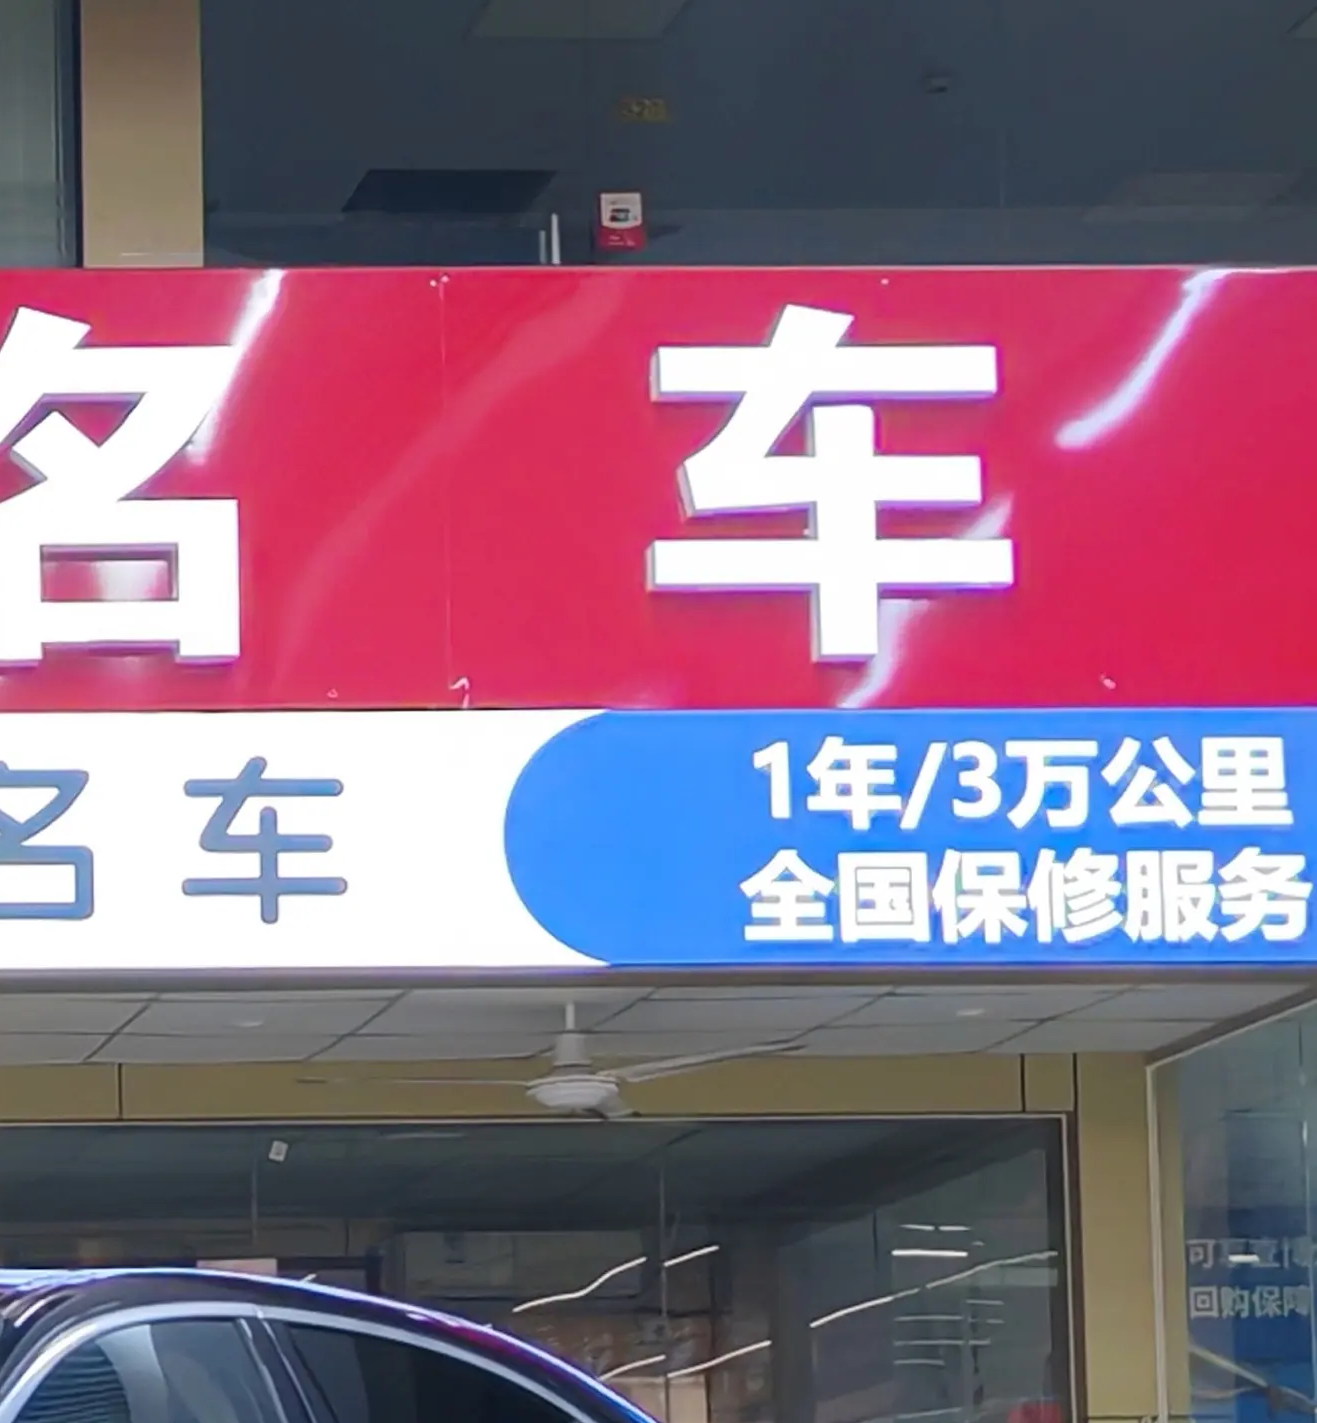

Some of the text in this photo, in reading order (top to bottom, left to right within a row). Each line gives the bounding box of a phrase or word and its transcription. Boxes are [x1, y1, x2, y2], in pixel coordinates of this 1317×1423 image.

[752, 736, 1294, 831] 1年/3万公里
[738, 848, 1312, 944] 全国保修服务
